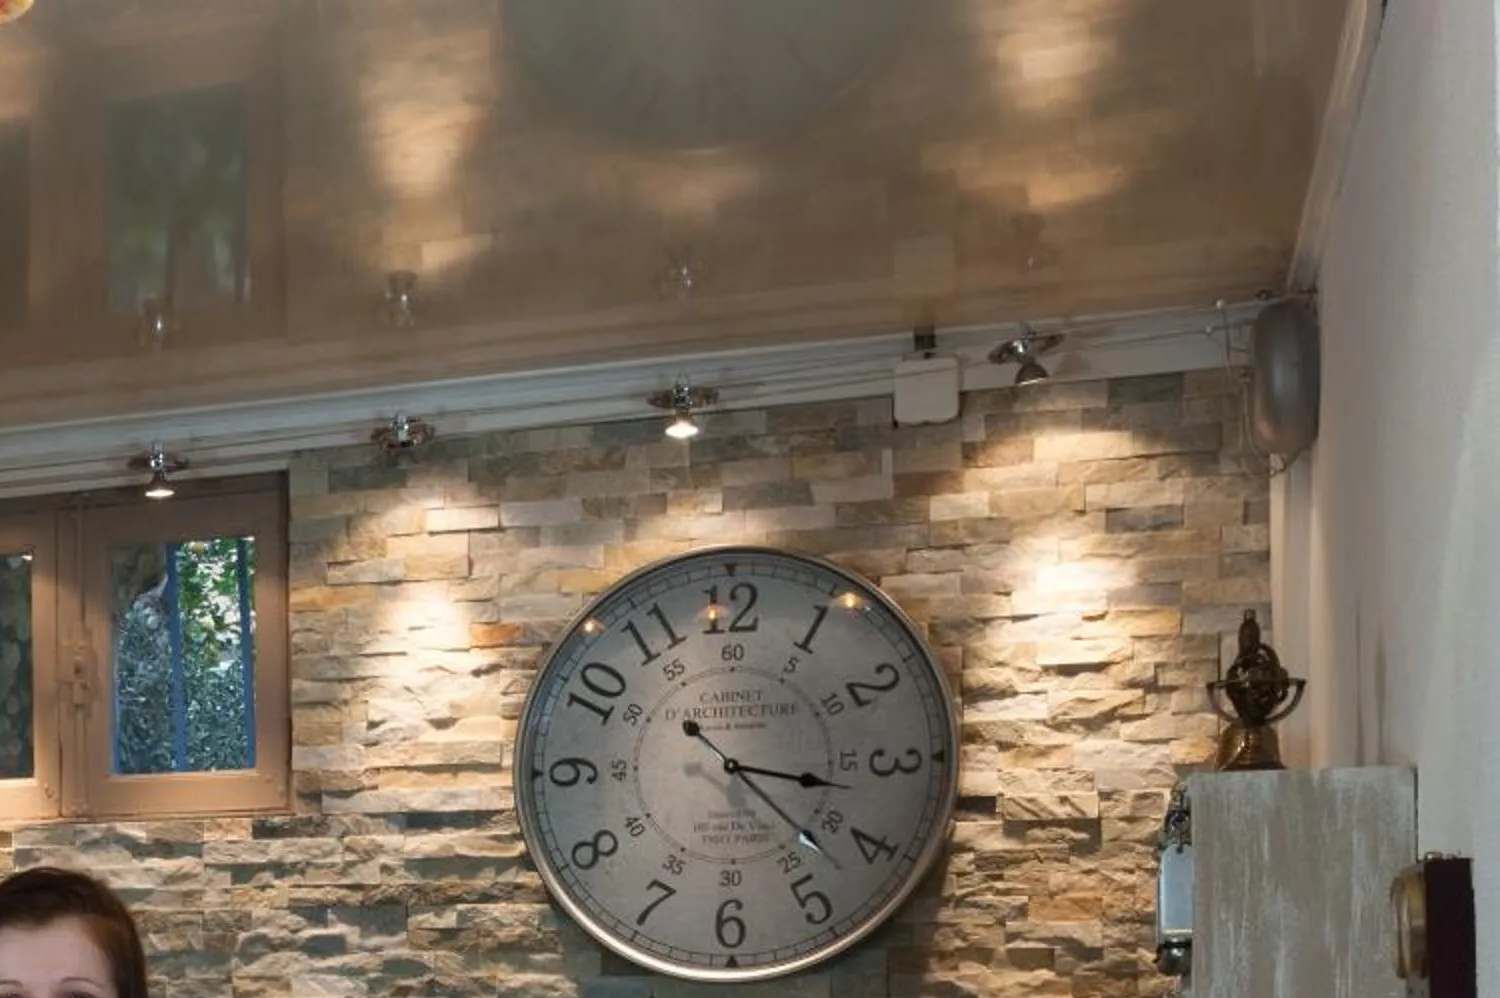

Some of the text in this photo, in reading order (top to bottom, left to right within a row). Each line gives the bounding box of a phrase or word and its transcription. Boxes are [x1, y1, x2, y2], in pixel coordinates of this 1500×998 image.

[702, 583, 759, 634] 12
[621, 603, 687, 667] 11
[793, 604, 829, 654] 1
[721, 643, 745, 661] 60
[663, 658, 686, 681] 55
[784, 656, 800, 673] 5
[567, 662, 626, 725] 10
[700, 690, 763, 702] CABINET
[846, 663, 900, 707] 2
[623, 703, 644, 726] 50
[820, 692, 845, 716] 10
[550, 757, 598, 787] 9
[611, 759, 627, 781] 45
[839, 751, 858, 771] 15
[869, 748, 922, 777] 3
[624, 816, 645, 837] 40
[821, 810, 844, 834] 20
[572, 829, 618, 870] 8
[850, 826, 899, 864] 4
[662, 854, 686, 876] 35
[776, 851, 801, 874] 25
[720, 869, 743, 887] 30
[636, 879, 677, 926] 7
[791, 874, 833, 924] 5
[715, 899, 746, 949] 6
